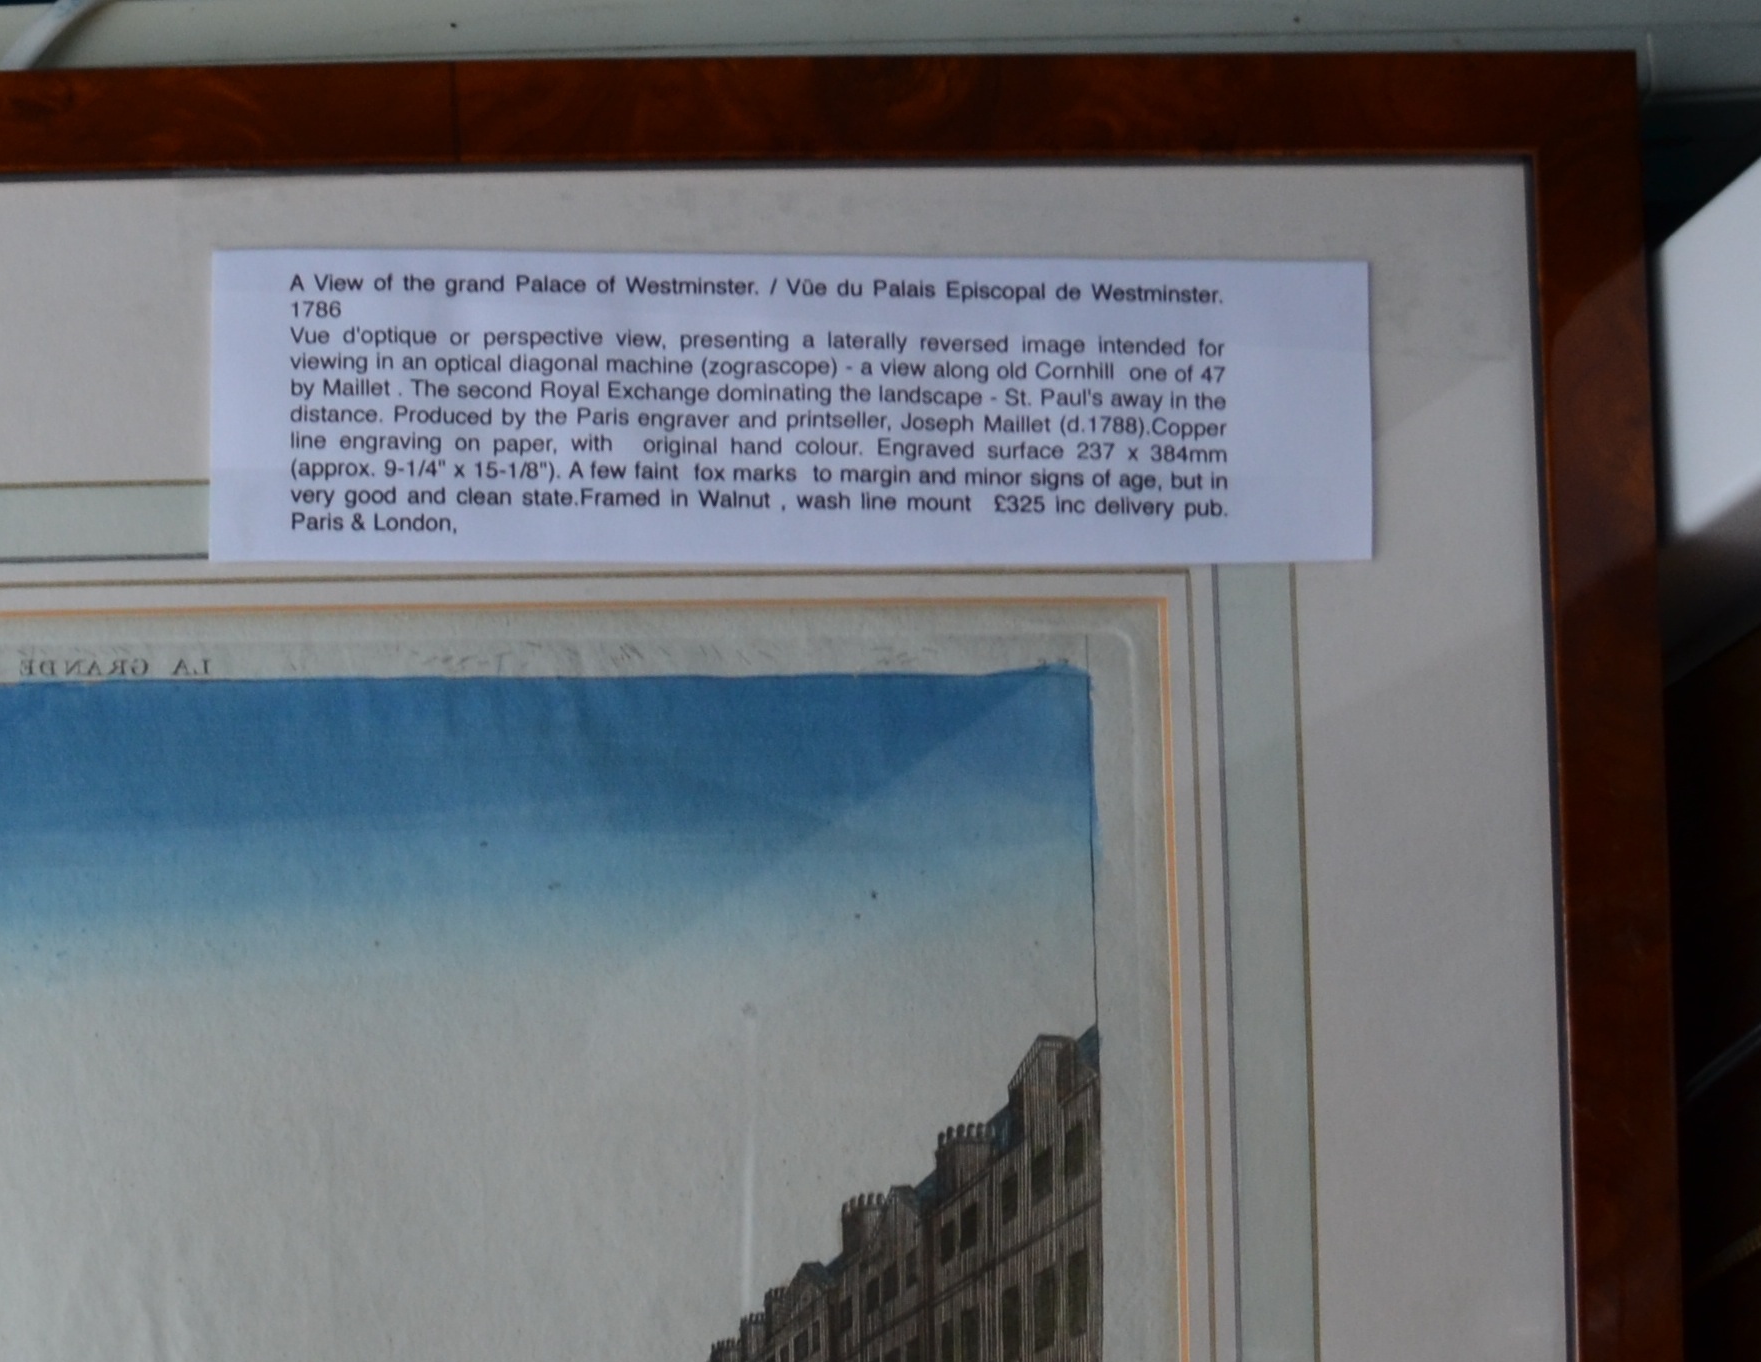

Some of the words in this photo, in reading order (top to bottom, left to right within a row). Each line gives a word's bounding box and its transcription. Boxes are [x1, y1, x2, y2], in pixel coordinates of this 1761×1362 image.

[289, 273, 306, 293] A
[313, 273, 365, 293] View
[373, 272, 394, 293] of
[402, 273, 436, 294] the
[444, 274, 505, 299] grand
[515, 273, 587, 295] Palace
[595, 274, 616, 295] of
[625, 275, 759, 297] Westminster.
[836, 278, 863, 298] du
[872, 278, 937, 300] Palais
[945, 279, 1046, 305] Episcopal
[1054, 282, 1082, 302] de
[1090, 282, 1223, 305] Westminster.
[291, 300, 342, 320] 1786
[289, 325, 331, 346] Vue
[342, 325, 438, 349] d'optique
[449, 331, 471, 347] or
[483, 326, 604, 351] perspective
[615, 328, 667, 351] view,
[679, 330, 790, 354] presenting
[801, 333, 816, 350] a
[827, 330, 908, 355] laterally
[919, 334, 1009, 354] reversed
[1021, 335, 1086, 359] image
[1098, 335, 1186, 357] intended
[1197, 337, 1225, 358] for
[289, 351, 369, 376] viewing
[375, 351, 394, 371] in
[401, 355, 428, 371] an
[434, 353, 502, 377] optical
[508, 353, 599, 378] diagonal
[605, 355, 694, 376] machine
[700, 356, 838, 381] (zograscope)
[859, 360, 874, 377] a
[879, 357, 927, 378] view
[932, 360, 990, 385] along
[996, 360, 1028, 381] old
[1034, 360, 1115, 381] Cornhill
[1128, 366, 1168, 383] one
[1173, 363, 1194, 384] of
[1200, 365, 1226, 384] 47
[290, 377, 316, 402] by
[322, 377, 391, 398] Maillet
[409, 377, 451, 399] The
[456, 380, 532, 401] second
[540, 379, 600, 404] Royal
[607, 379, 711, 407] Exchange
[716, 382, 832, 408] dominating
[838, 383, 872, 403] the
[878, 384, 983, 411] landscape
[1004, 386, 1032, 408] St.
[1040, 387, 1104, 408] Paul's
[1110, 392, 1164, 414] away
[1169, 390, 1188, 411] in
[1193, 391, 1227, 412] the
[289, 404, 384, 424] distance.
[393, 404, 493, 427] Produced
[501, 407, 527, 431] by
[534, 406, 568, 427] the
[576, 406, 630, 427] Paris
[637, 411, 730, 434] engraver
[737, 409, 777, 430] and
[786, 409, 892, 433] printseller,
[900, 411, 975, 437] Joseph
[983, 413, 1051, 434] Maillet
[290, 430, 327, 451] line
[338, 431, 442, 457] engraving
[454, 436, 481, 453] on
[493, 437, 558, 458] paper,
[570, 433, 613, 453] with
[642, 435, 718, 460] original
[730, 436, 783, 456] hand
[794, 436, 863, 457] colour.
[877, 436, 975, 463] Engraved
[987, 440, 1065, 461] surface
[1076, 441, 1116, 461] 237
[1127, 446, 1139, 462] x
[1150, 443, 1228, 464] 384mm
[290, 457, 376, 482] (approx.
[453, 463, 466, 479] x
[567, 459, 585, 480] A
[589, 459, 627, 481] few
[634, 460, 680, 482] faint
[693, 462, 726, 483] fox
[732, 463, 798, 483] marks
[812, 464, 833, 484] to
[839, 464, 912, 490] margin
[918, 466, 957, 487] and
[964, 467, 1023, 488] minor
[1029, 467, 1085, 493] signs
[1091, 468, 1112, 489] of
[1118, 472, 1163, 495] age,
[1170, 470, 1204, 491] but
[1210, 471, 1229, 491] in
[289, 488, 336, 509] very
[343, 485, 397, 510] good
[406, 485, 447, 506] and
[455, 486, 513, 507] clean
[670, 488, 689, 508] in
[697, 488, 771, 510] Walnut
[795, 490, 851, 511] wash
[860, 491, 898, 512] line
[906, 494, 972, 513] mount
[993, 493, 1046, 515] £325
[1055, 494, 1086, 515] inc
[1094, 495, 1175, 521] delivery
[1183, 498, 1228, 522] pub.
[290, 511, 345, 532] Paris
[350, 511, 366, 532] &
[373, 512, 458, 535] London,
